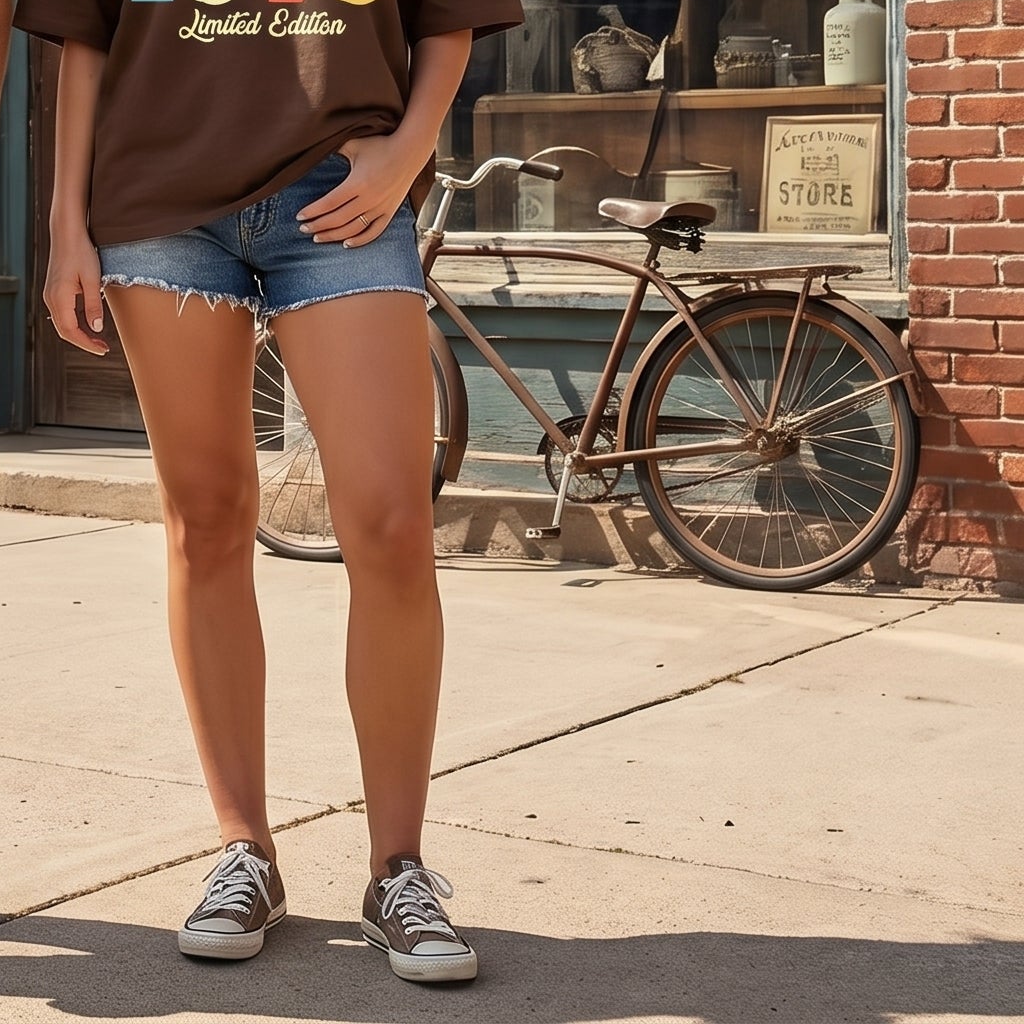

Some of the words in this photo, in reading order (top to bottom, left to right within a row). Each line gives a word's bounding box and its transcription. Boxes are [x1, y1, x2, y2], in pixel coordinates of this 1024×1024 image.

[178, 8, 263, 43] Limited
[268, 8, 347, 38] Edition
[779, 180, 853, 207] STORE
